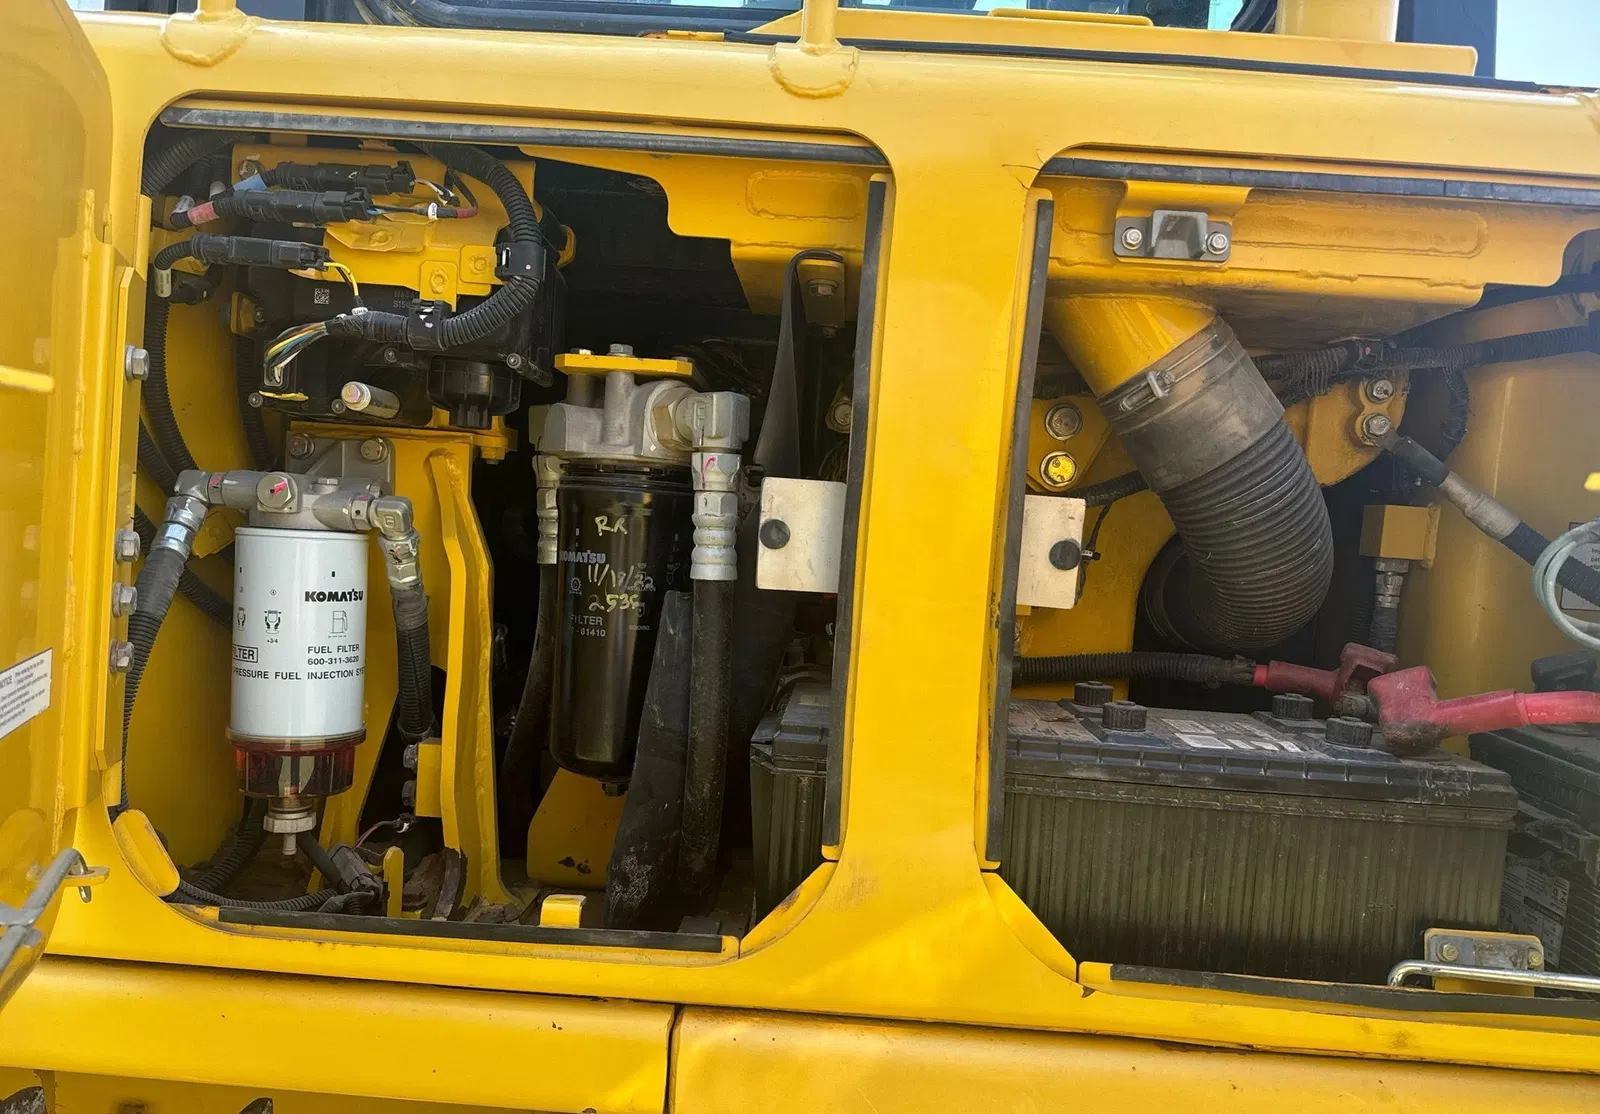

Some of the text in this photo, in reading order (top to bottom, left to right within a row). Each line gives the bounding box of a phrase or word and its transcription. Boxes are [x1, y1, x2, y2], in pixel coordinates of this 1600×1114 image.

[304, 588, 364, 603] KOMATSU
[307, 643, 359, 654] FUEL FILTER
[307, 655, 359, 665] 600-311-3620
[274, 671, 301, 680] FUEL
[307, 669, 354, 680] INJECTION
